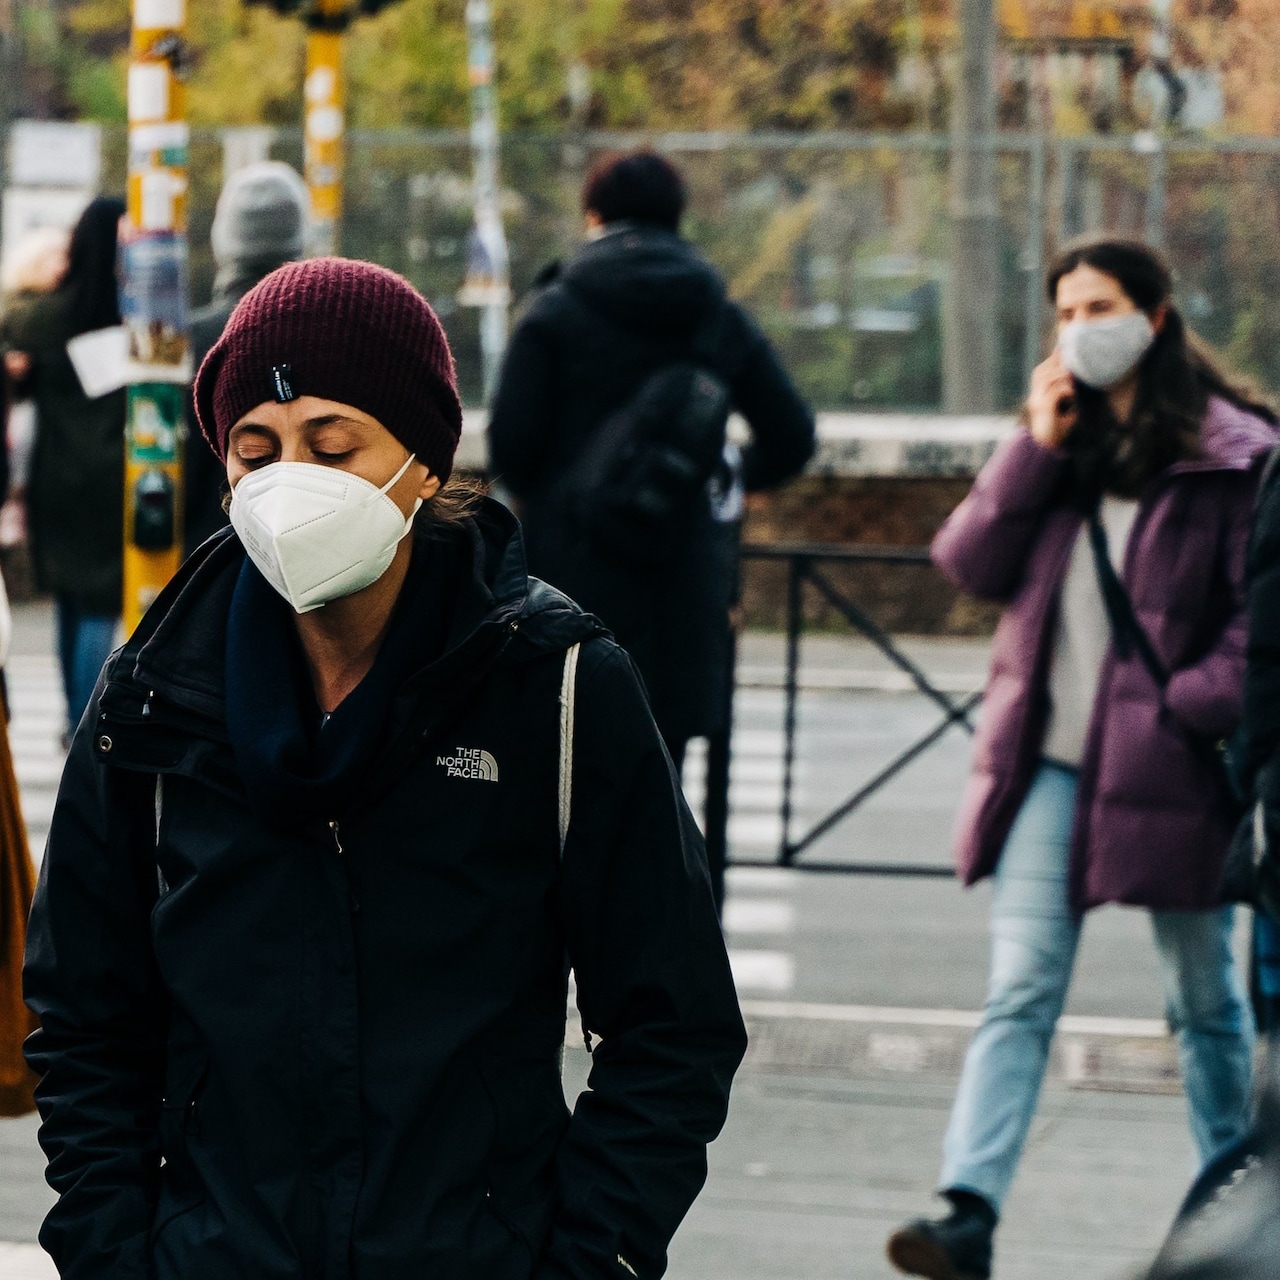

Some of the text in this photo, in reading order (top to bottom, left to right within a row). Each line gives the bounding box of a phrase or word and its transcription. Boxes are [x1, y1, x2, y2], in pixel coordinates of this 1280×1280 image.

[456, 747, 481, 759] THE
[436, 756, 480, 768] NORTH
[447, 766, 479, 778] FACE
